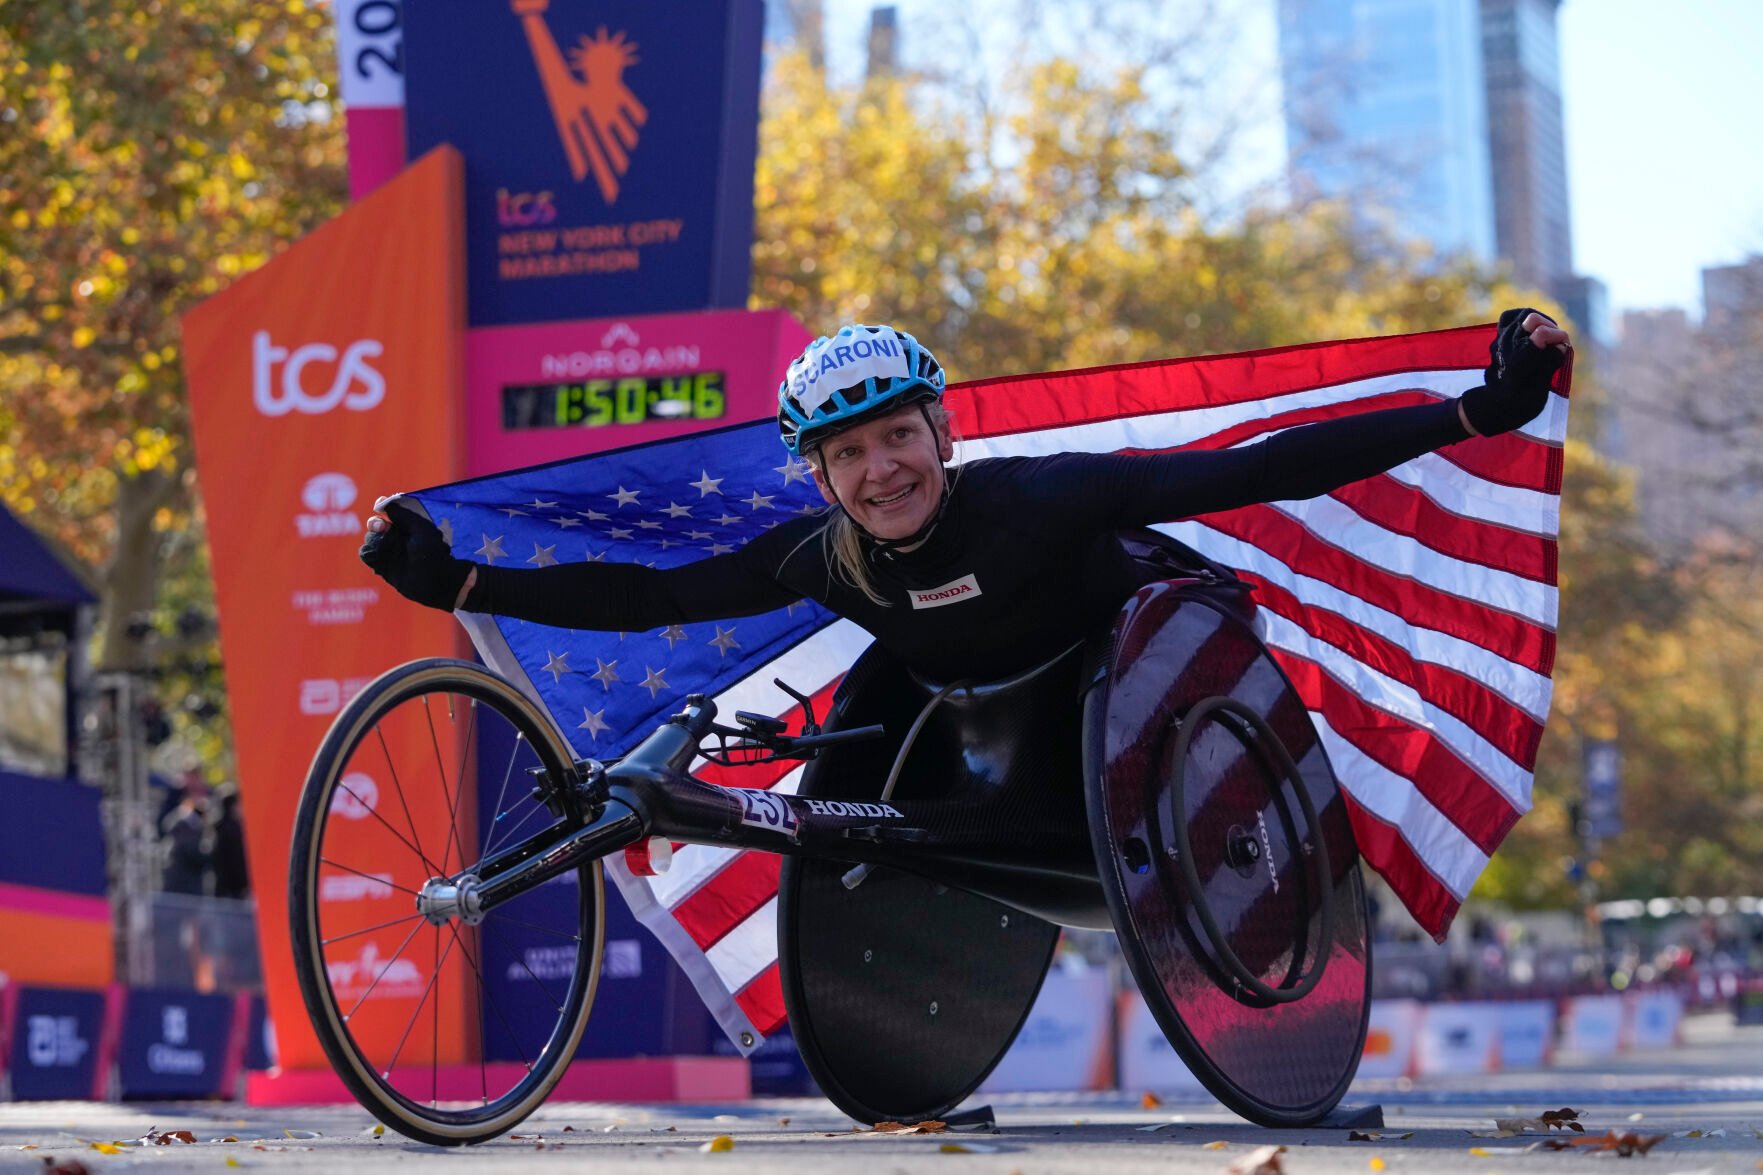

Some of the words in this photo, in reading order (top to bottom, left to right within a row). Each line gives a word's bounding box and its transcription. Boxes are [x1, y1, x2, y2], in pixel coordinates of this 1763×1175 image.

[497, 188, 557, 225] tcs
[499, 232, 557, 254] NEW
[562, 226, 624, 249] YORK
[628, 218, 682, 245] CITY
[499, 250, 640, 279] MARATHON
[253, 329, 386, 416] tcs
[794, 339, 900, 396] SCARONI
[295, 513, 361, 536] TATA
[917, 584, 973, 602] HONDA
[736, 715, 758, 726] GARMIN
[729, 787, 797, 831] 252
[804, 800, 904, 818] HONDA
[1256, 810, 1280, 895] HONDA
